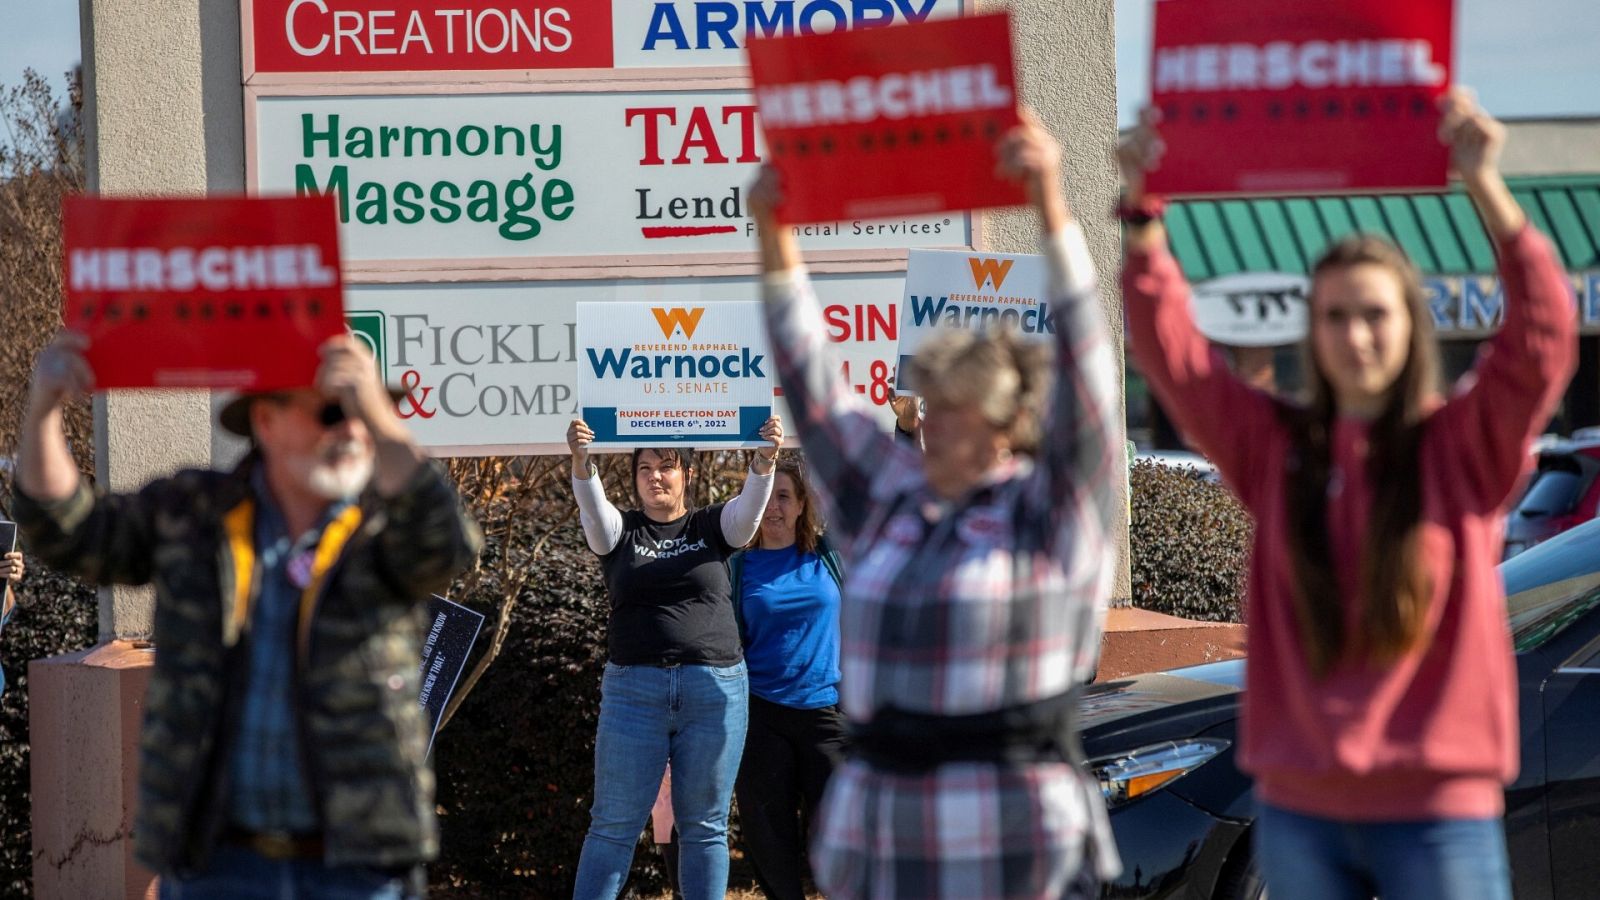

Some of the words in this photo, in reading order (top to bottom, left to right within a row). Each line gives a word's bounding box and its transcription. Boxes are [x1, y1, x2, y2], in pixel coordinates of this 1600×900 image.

[285, 0, 572, 56] CREATIONS
[1156, 38, 1446, 92] HERSCHEL
[757, 64, 1010, 127] HERSCHEL
[301, 113, 561, 170] Harmony
[295, 164, 574, 240] Massage
[635, 187, 751, 219] Lend
[71, 243, 336, 291] HERSCHEL
[911, 295, 1056, 334] Warnock
[950, 294, 994, 303] REVEREND
[998, 296, 1037, 306] RAPHAEL
[586, 348, 765, 379] Warnock
[644, 383, 670, 393] U.S.
[677, 383, 728, 393] SENATE
[619, 410, 660, 418] RUNOFF
[664, 410, 714, 418] ELECTION
[631, 420, 684, 428] DECEMBER
[634, 538, 708, 559] WARNOCK
[431, 611, 447, 633] KNOW
[426, 631, 438, 646] YOU
[422, 672, 437, 693] KNEW
